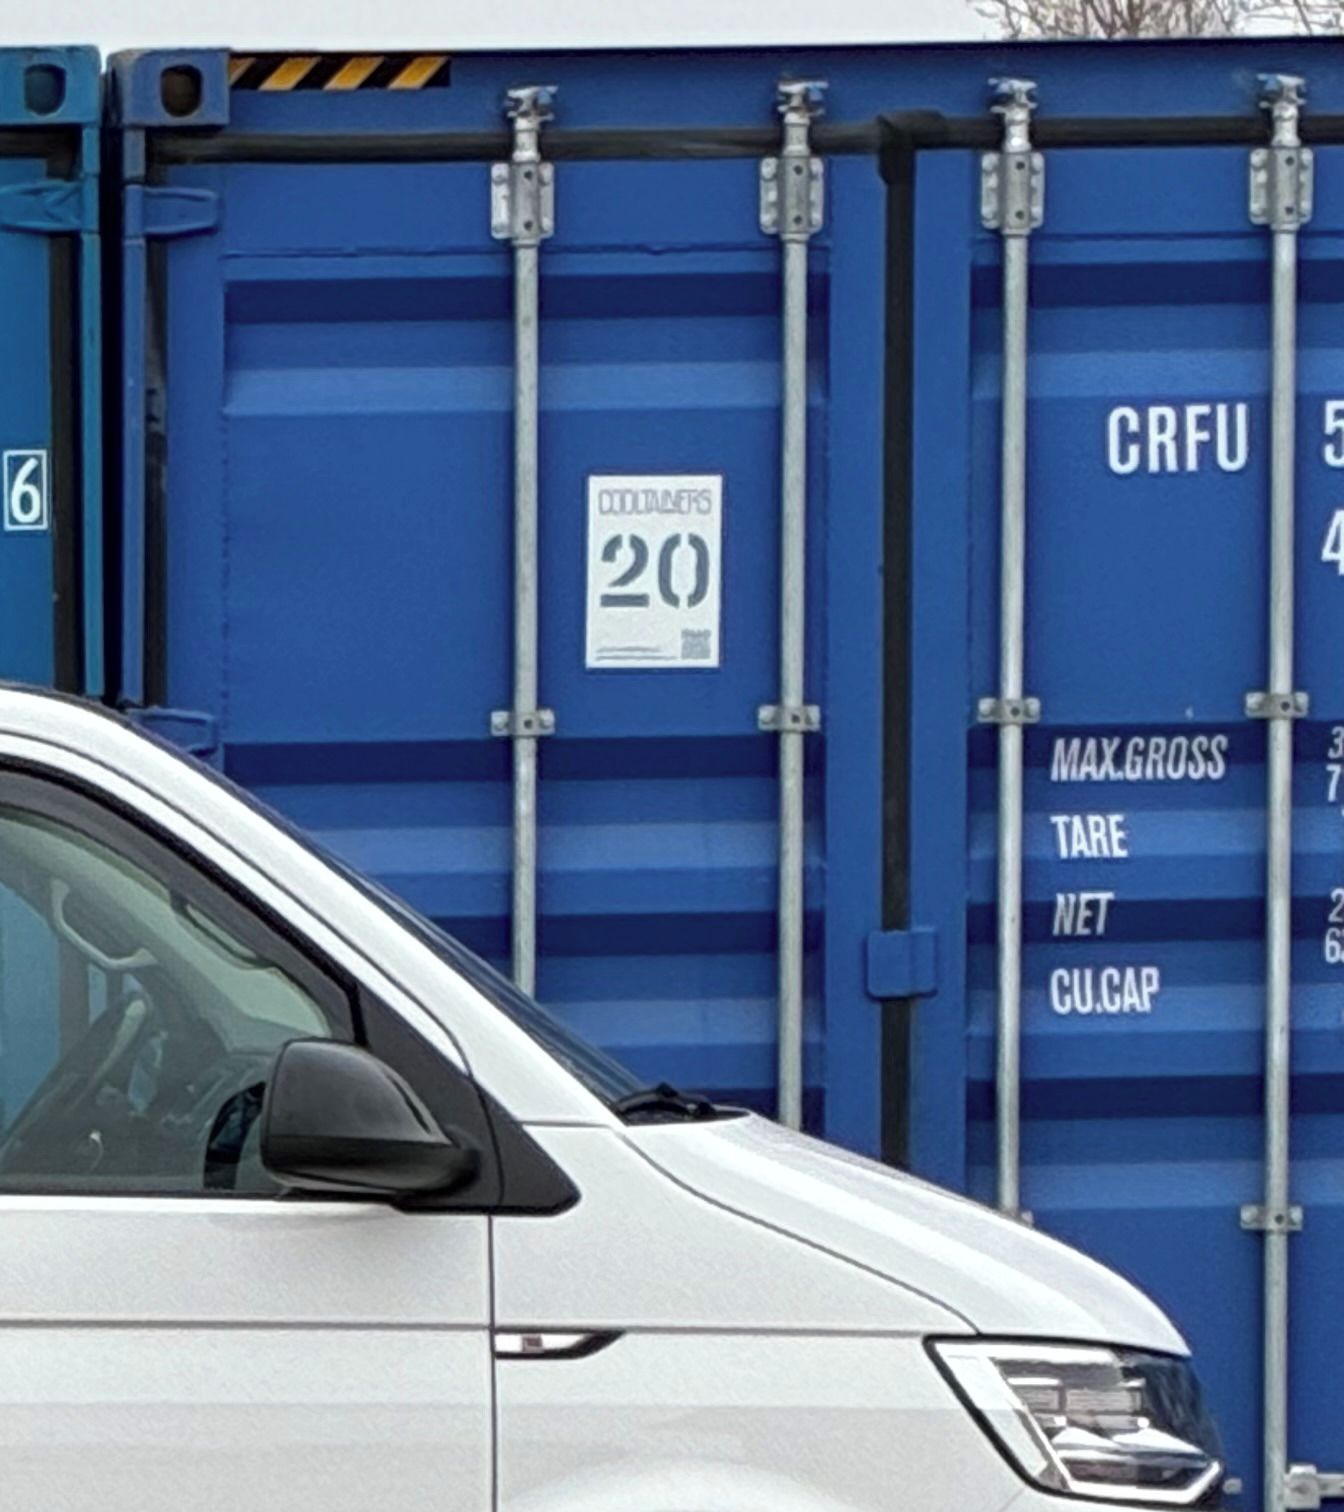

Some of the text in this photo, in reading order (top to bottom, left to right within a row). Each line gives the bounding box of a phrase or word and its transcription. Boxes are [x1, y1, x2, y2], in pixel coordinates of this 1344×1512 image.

[1108, 402, 1249, 474] CRFU
[11, 457, 42, 525] 6
[600, 533, 710, 609] 20
[1050, 734, 1229, 782] MAX.GROSS
[1050, 813, 1129, 860] TARE
[1053, 890, 1116, 936] NET
[1050, 966, 1161, 1015] CU.CAP
